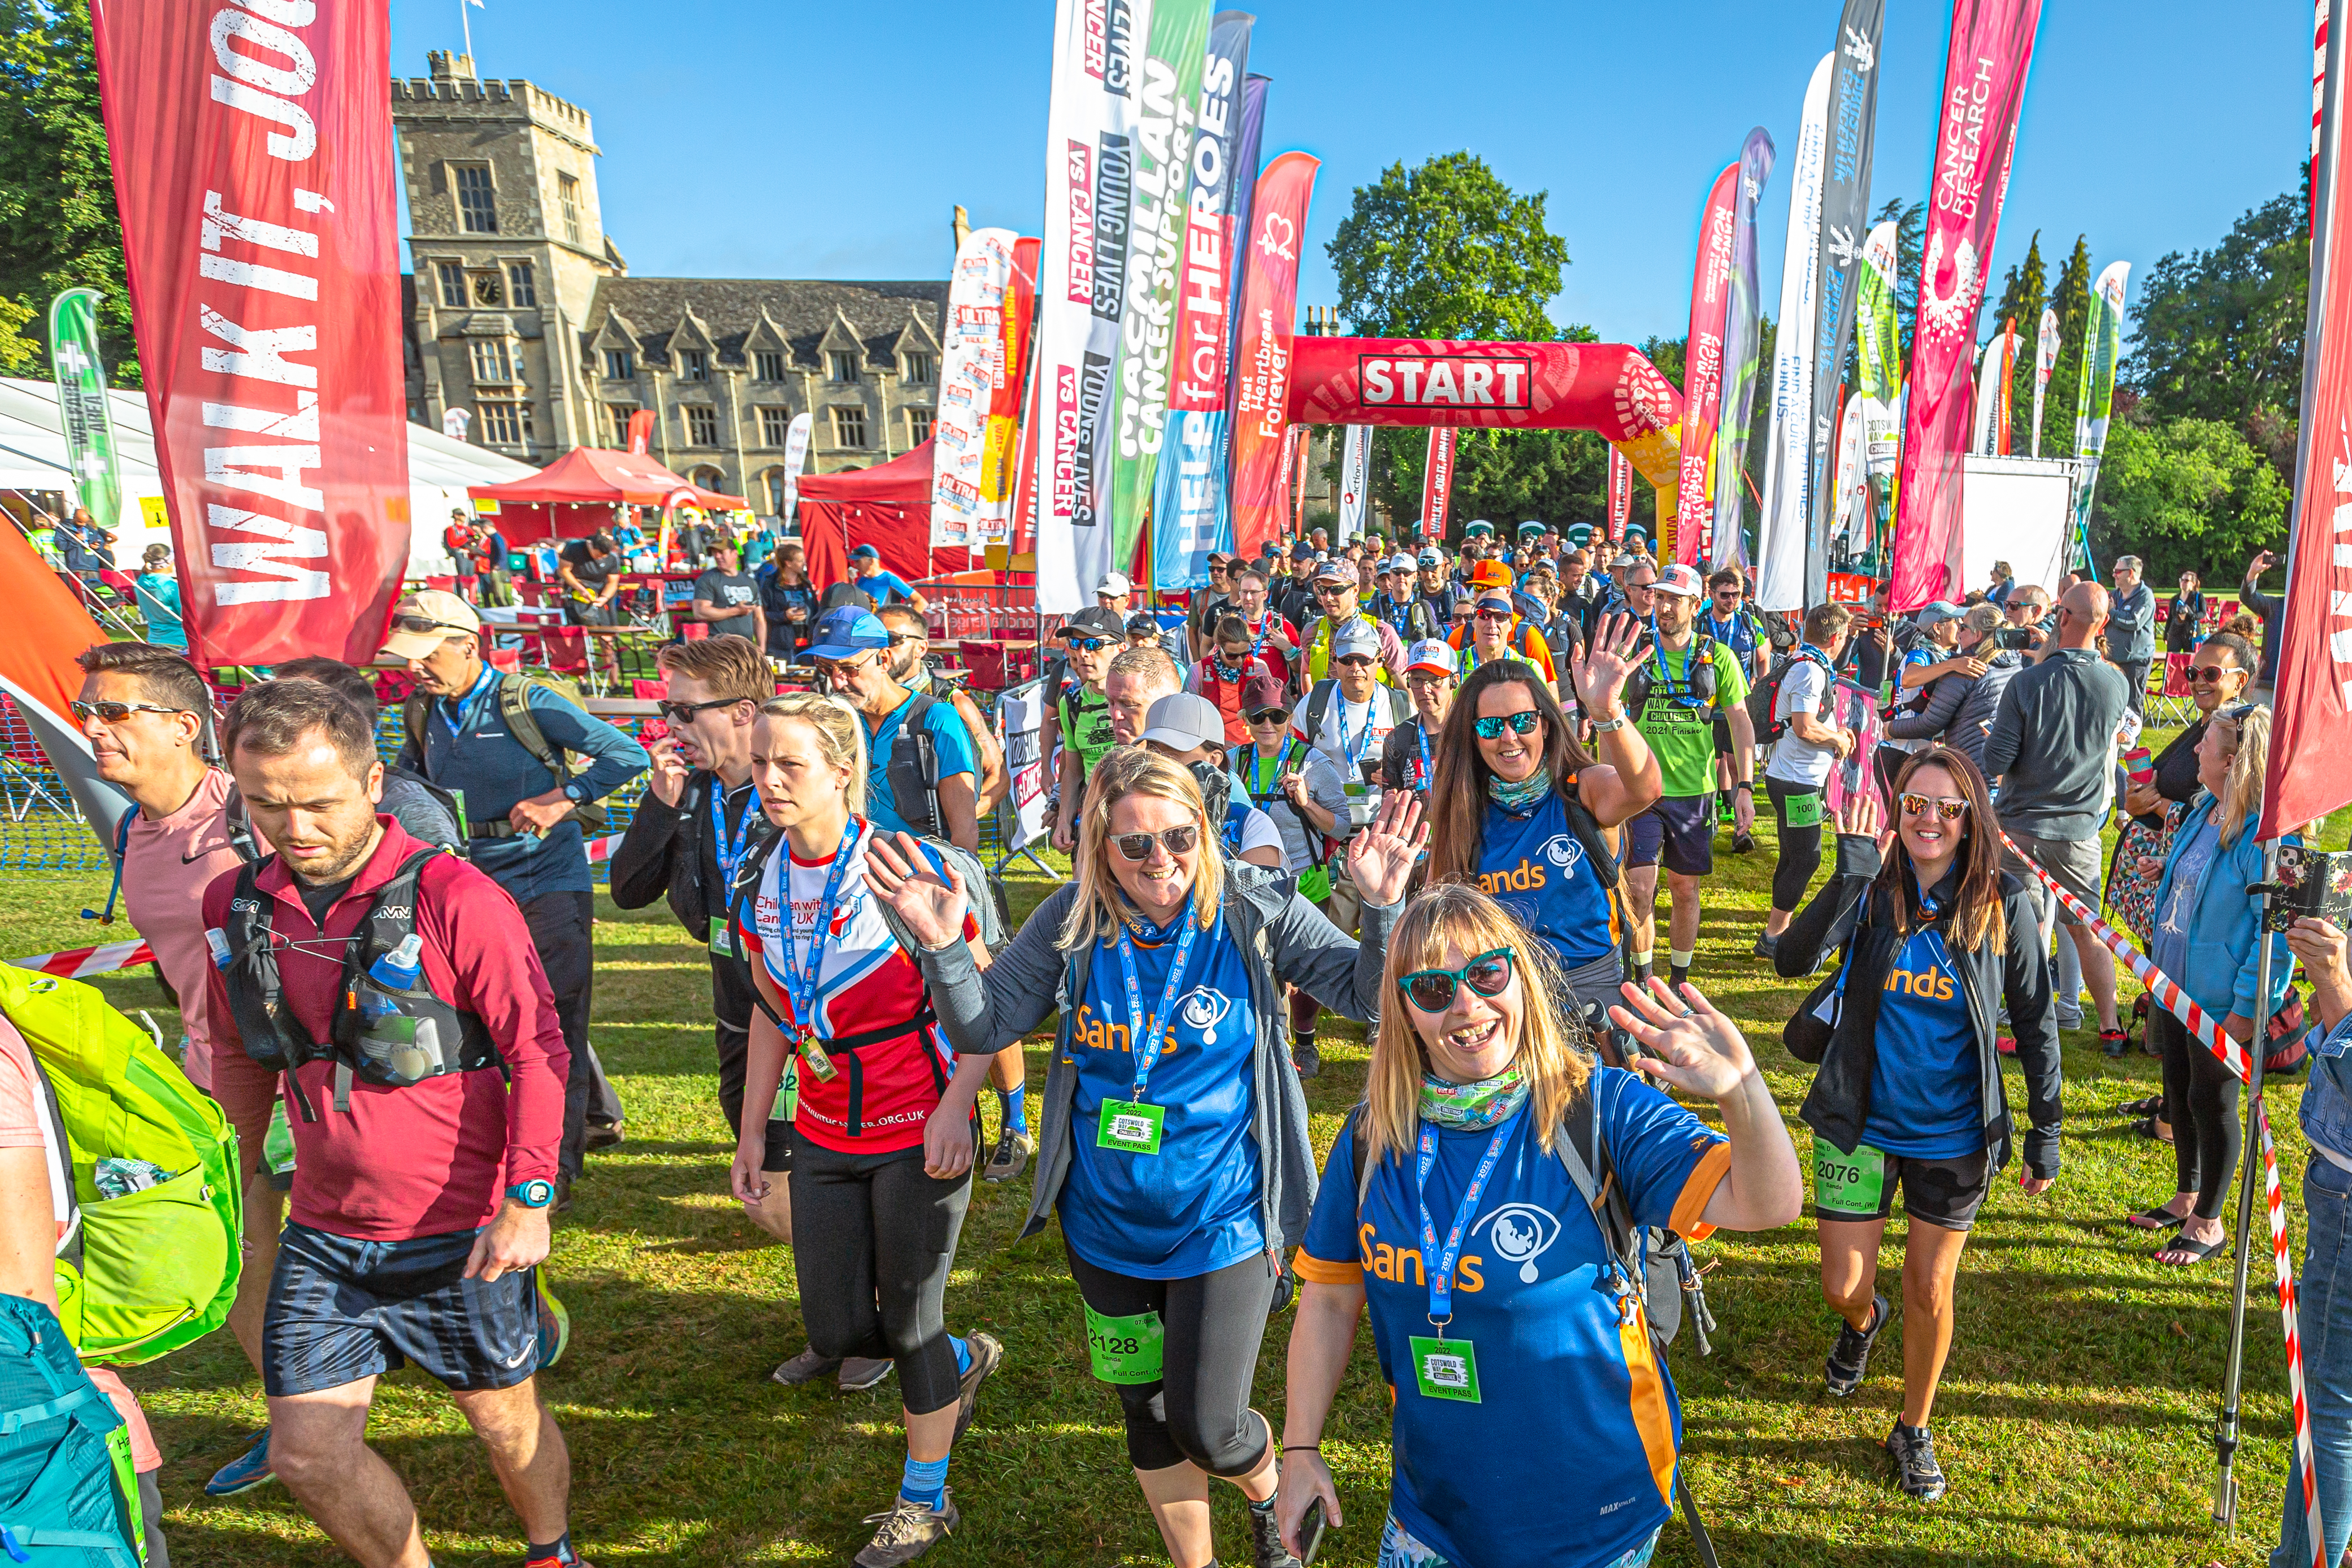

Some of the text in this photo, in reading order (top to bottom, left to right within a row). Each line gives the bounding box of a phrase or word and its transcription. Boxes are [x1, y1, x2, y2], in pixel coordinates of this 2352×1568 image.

[1834, 67, 1858, 185] CANCER UK
[1845, 73, 1864, 183] PROSTATE
[1952, 57, 1994, 216] RESEARCH
[1937, 85, 1969, 210] CANCER
[1187, 53, 1234, 315] HEROES
[1070, 188, 1093, 299] CANCER
[1093, 143, 1130, 315] YOUNG LIVES
[1712, 205, 1726, 251] NOW
[199, 188, 336, 302] IT,
[1119, 58, 1177, 457] MACMILLAN
[1720, 210, 1734, 284] CANCER
[1138, 96, 1194, 454] CANCER SUPPORT
[961, 308, 1001, 324] ULTRA
[1825, 269, 1845, 373] PROSTATE
[1182, 320, 1218, 402] for
[1251, 308, 1273, 411] Heartbreak
[1696, 331, 1712, 379] NOW
[1705, 335, 1722, 407] CANCER
[1259, 343, 1288, 438] Forever
[1364, 360, 1525, 405] START
[1791, 355, 1800, 395] FIND
[1238, 375, 1253, 412] Beat
[1777, 390, 1788, 422] US.
[63, 377, 88, 447] WELFARE
[85, 396, 106, 434] AREA
[1868, 431, 1882, 442] WAY
[200, 303, 331, 607] WALK
[1055, 411, 1078, 516] CANCER
[941, 475, 978, 502] ULTRA
[1071, 452, 1091, 522] LIVES
[1435, 474, 1446, 493] JOG
[1430, 505, 1443, 534] WALK
[1614, 512, 1625, 538] WALK
[666, 580, 695, 593] LTRA
[1647, 698, 1665, 710] WAY
[1651, 712, 1692, 722] CHALLENGE
[1646, 726, 1668, 735] 2021
[1796, 803, 1816, 813] 1001
[836, 853, 845, 867] 2022
[1478, 859, 1546, 895] ands
[756, 896, 823, 911] Chilen wit
[756, 909, 814, 924] Canr UK
[804, 983, 812, 997] 2022
[1171, 968, 1181, 983] 2022
[1884, 966, 1954, 1000] nds
[1132, 994, 1140, 1008] 2022
[1074, 1004, 1178, 1054] Sans
[1149, 1039, 1159, 1054] 2022
[1118, 1118, 1144, 1127] COTSWOLD
[1107, 1139, 1131, 1148] EVENT
[1420, 1156, 1430, 1176] 2022
[1478, 1159, 1490, 1179] 2022
[1817, 1161, 1860, 1184] 2076
[1360, 1223, 1484, 1292] Sans
[1441, 1250, 1452, 1271] 2022
[1089, 1327, 1139, 1355] 2128
[1101, 1354, 1122, 1362] Sands
[1431, 1358, 1457, 1368] COTSWOLD
[1428, 1385, 1472, 1397] EVENT PASS
[1600, 1501, 1620, 1516] MAX
